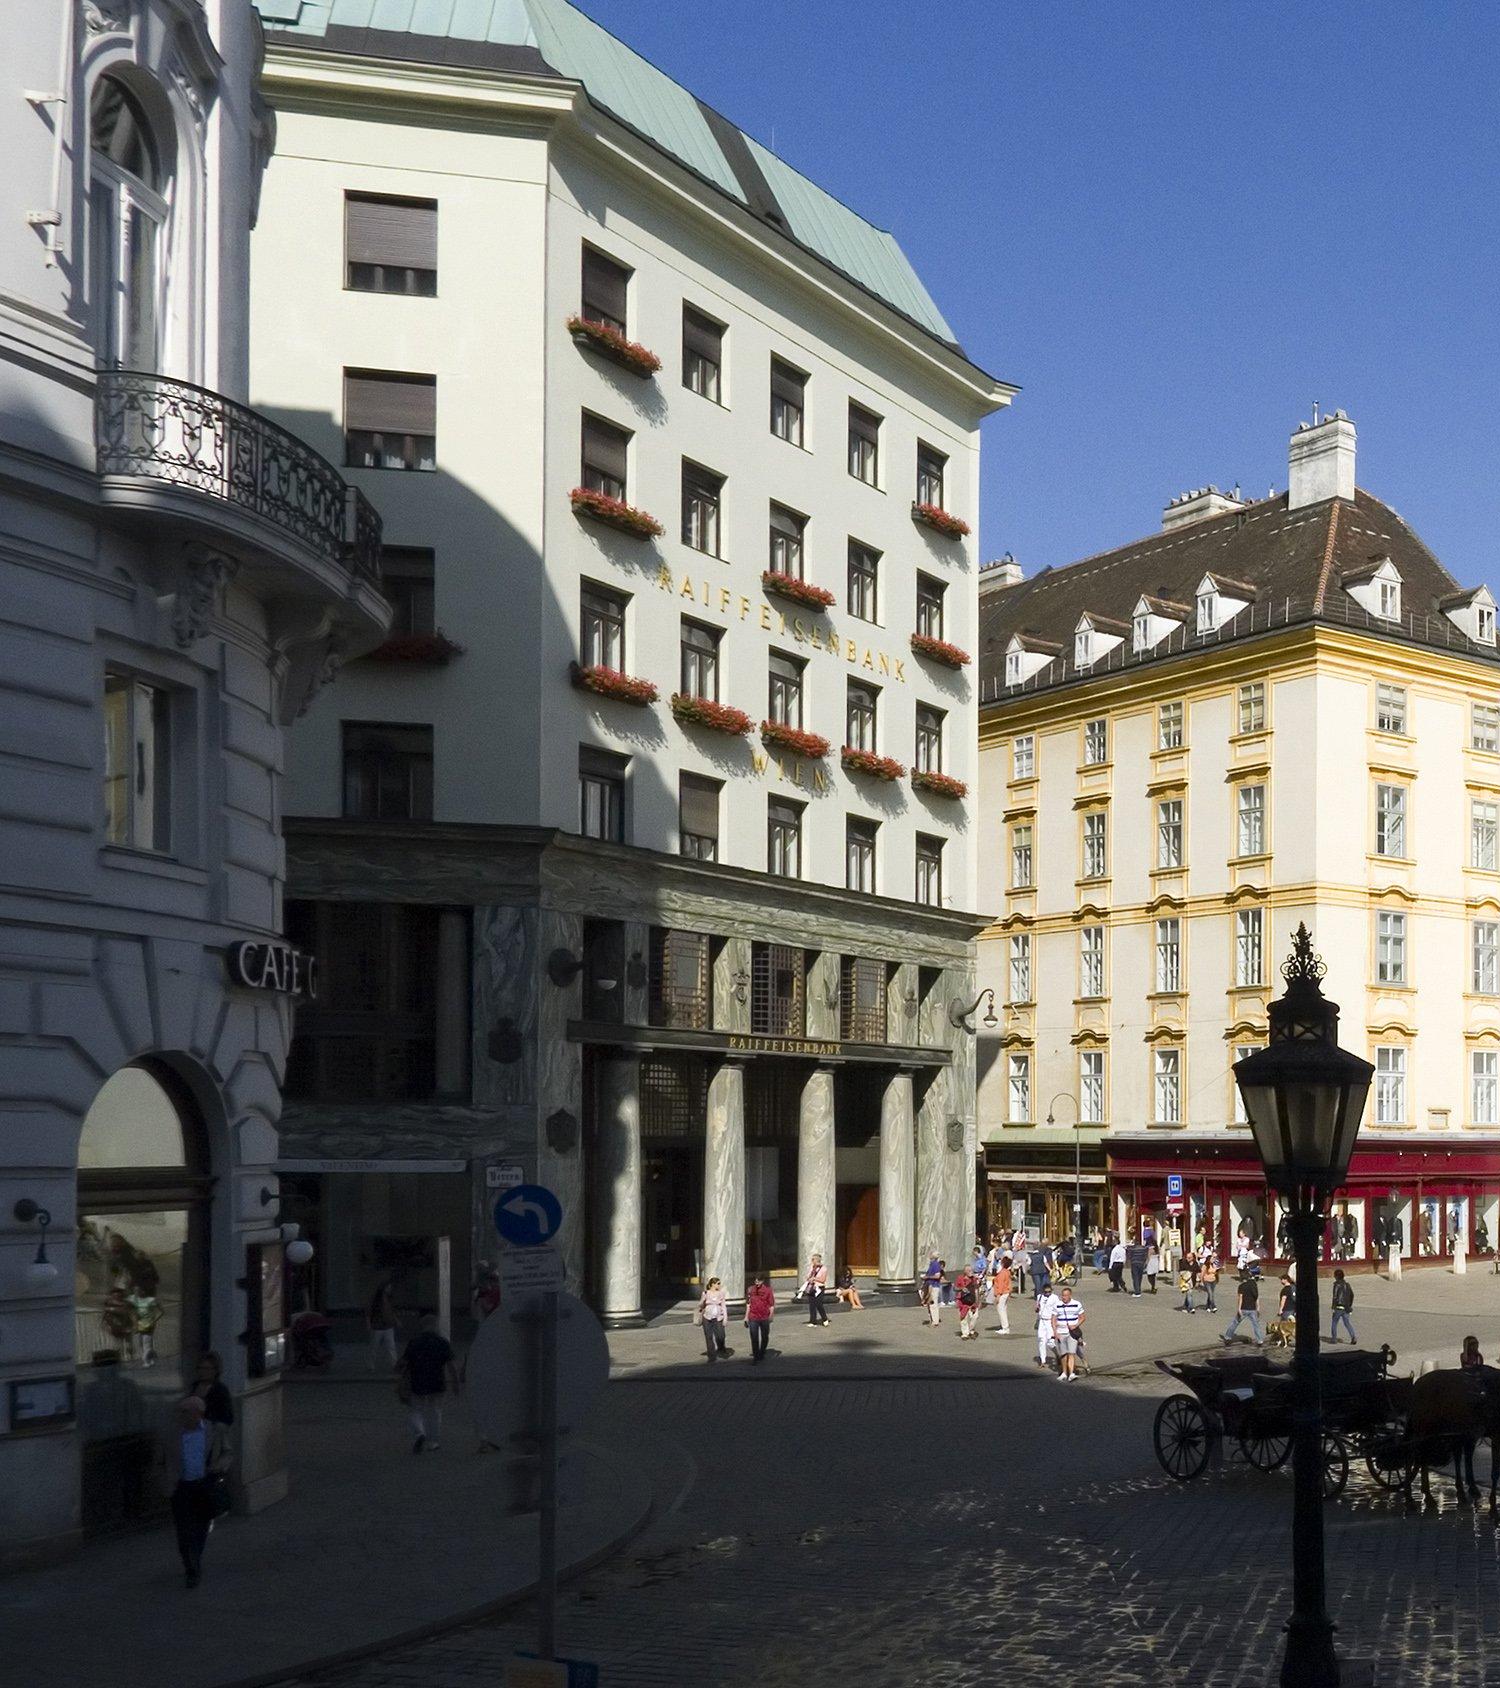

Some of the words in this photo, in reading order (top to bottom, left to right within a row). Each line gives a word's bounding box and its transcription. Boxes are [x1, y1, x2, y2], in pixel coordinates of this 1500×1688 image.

[658, 565, 905, 683] RAIFFEISENBANK
[751, 748, 827, 791] WIEN
[239, 941, 301, 993] CAFE
[729, 1036, 842, 1056] RAIFFEISENBANK
